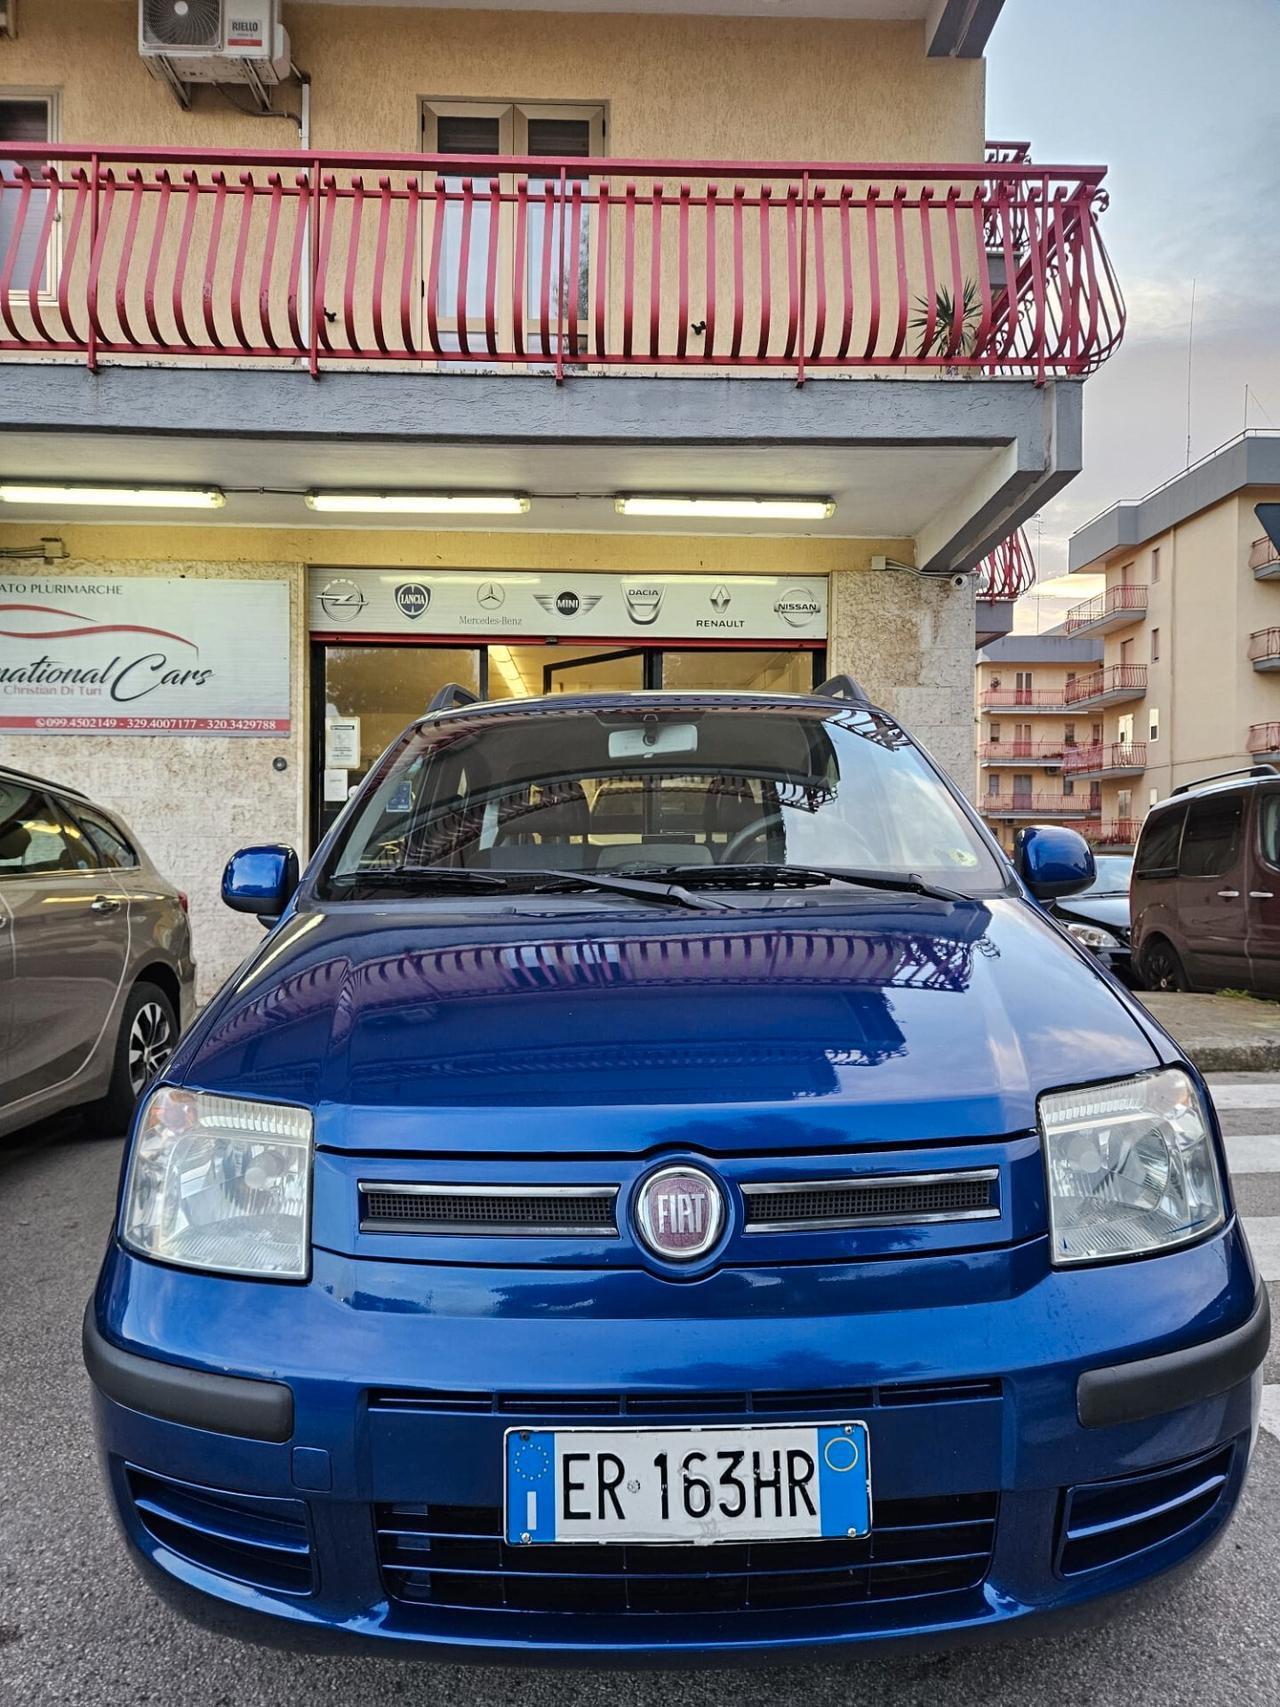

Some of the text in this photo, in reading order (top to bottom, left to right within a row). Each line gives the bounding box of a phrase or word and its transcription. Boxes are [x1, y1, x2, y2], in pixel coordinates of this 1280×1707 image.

[232, 21, 258, 32] RIELLO
[0, 583, 124, 595] ATO PLURIMARCHE
[628, 588, 660, 597] DACIA
[400, 593, 426, 606] LANCIA
[556, 599, 579, 610] MINI
[778, 602, 817, 612] NISSAN
[459, 615, 523, 627] Mercedes-Benz
[696, 619, 746, 628] RENAULT
[110, 653, 215, 702] Cars
[3, 685, 102, 696] Christian Di Turi
[46, 718, 117, 728] 099.4502149
[127, 719, 197, 729] 329.4007177
[207, 720, 277, 730] 320.3429788
[657, 1193, 706, 1234] FIAT
[562, 1450, 818, 1520] ER 163HR
